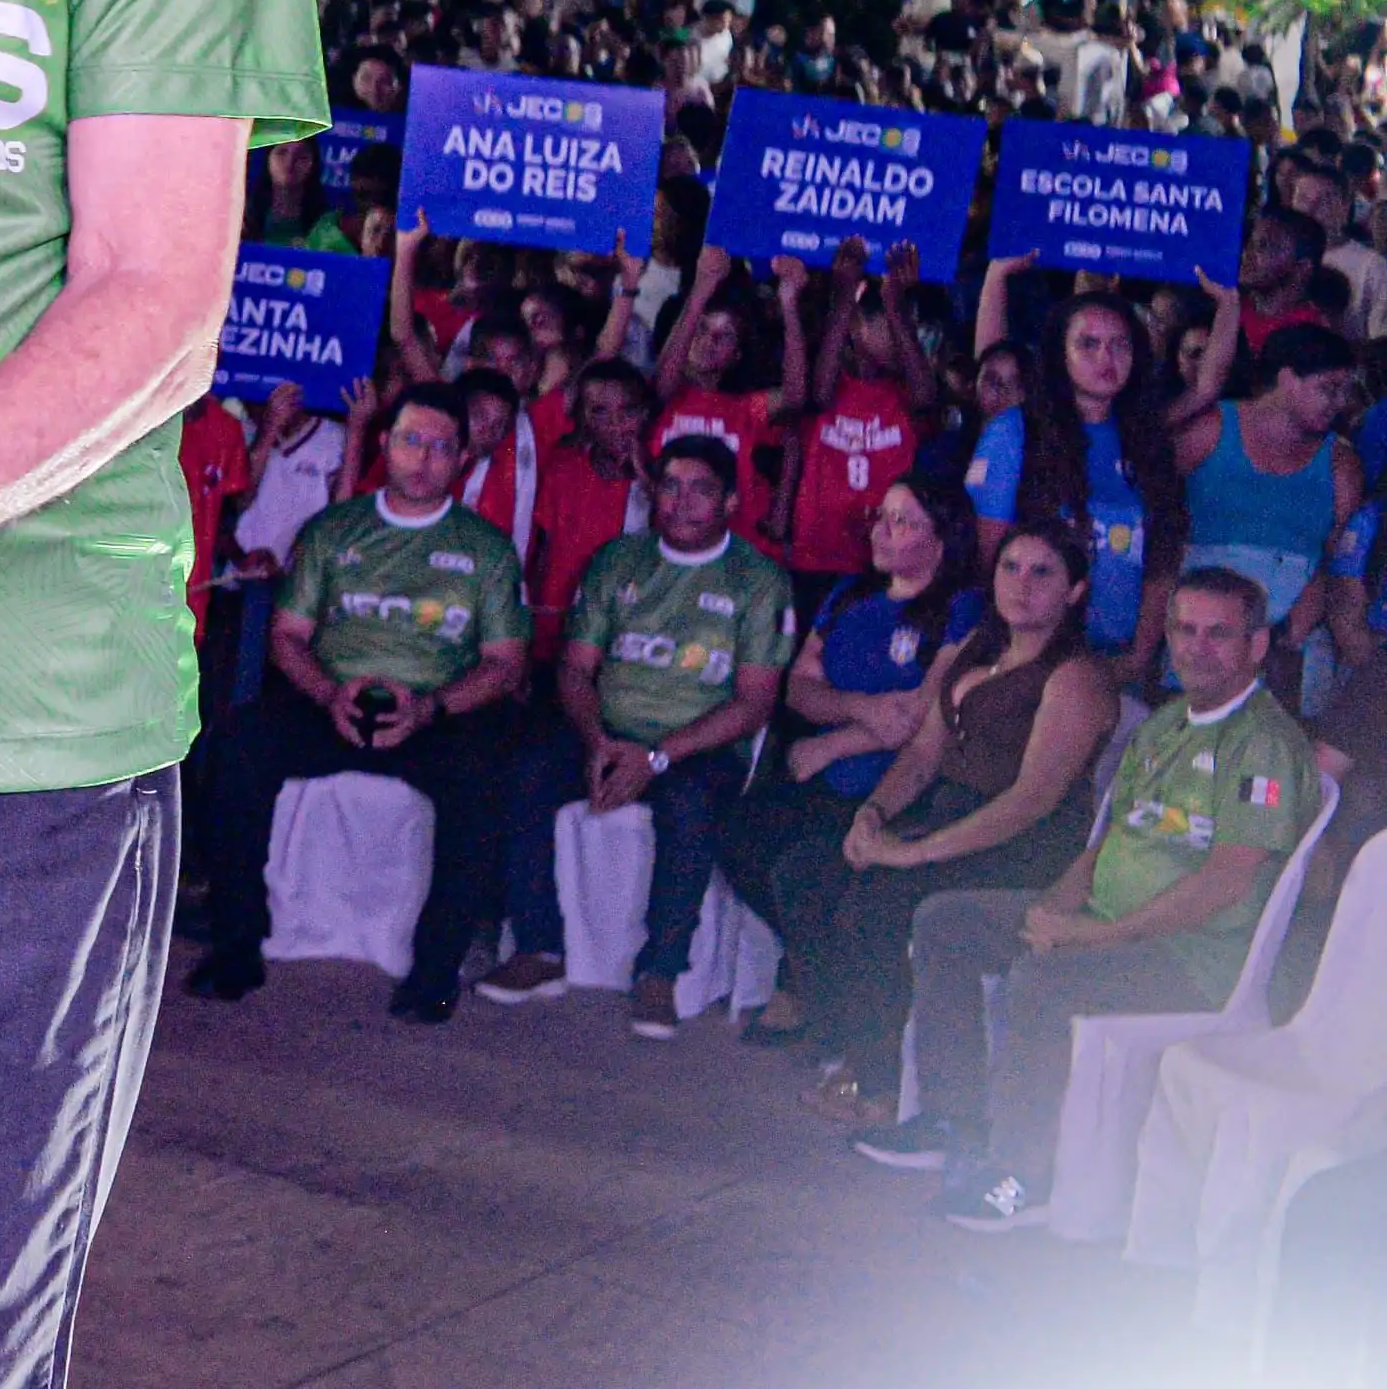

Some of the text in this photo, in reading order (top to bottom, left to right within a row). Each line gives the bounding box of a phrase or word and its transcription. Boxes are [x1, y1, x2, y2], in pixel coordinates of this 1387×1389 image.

[442, 124, 623, 174] ANA LUIZA
[463, 158, 598, 204] DO REIS
[760, 146, 935, 199] REINALDO
[1020, 168, 1224, 213] ESCOLA SANTA
[773, 180, 908, 227] ZAIDAM
[1047, 198, 1190, 238] FILOMENA
